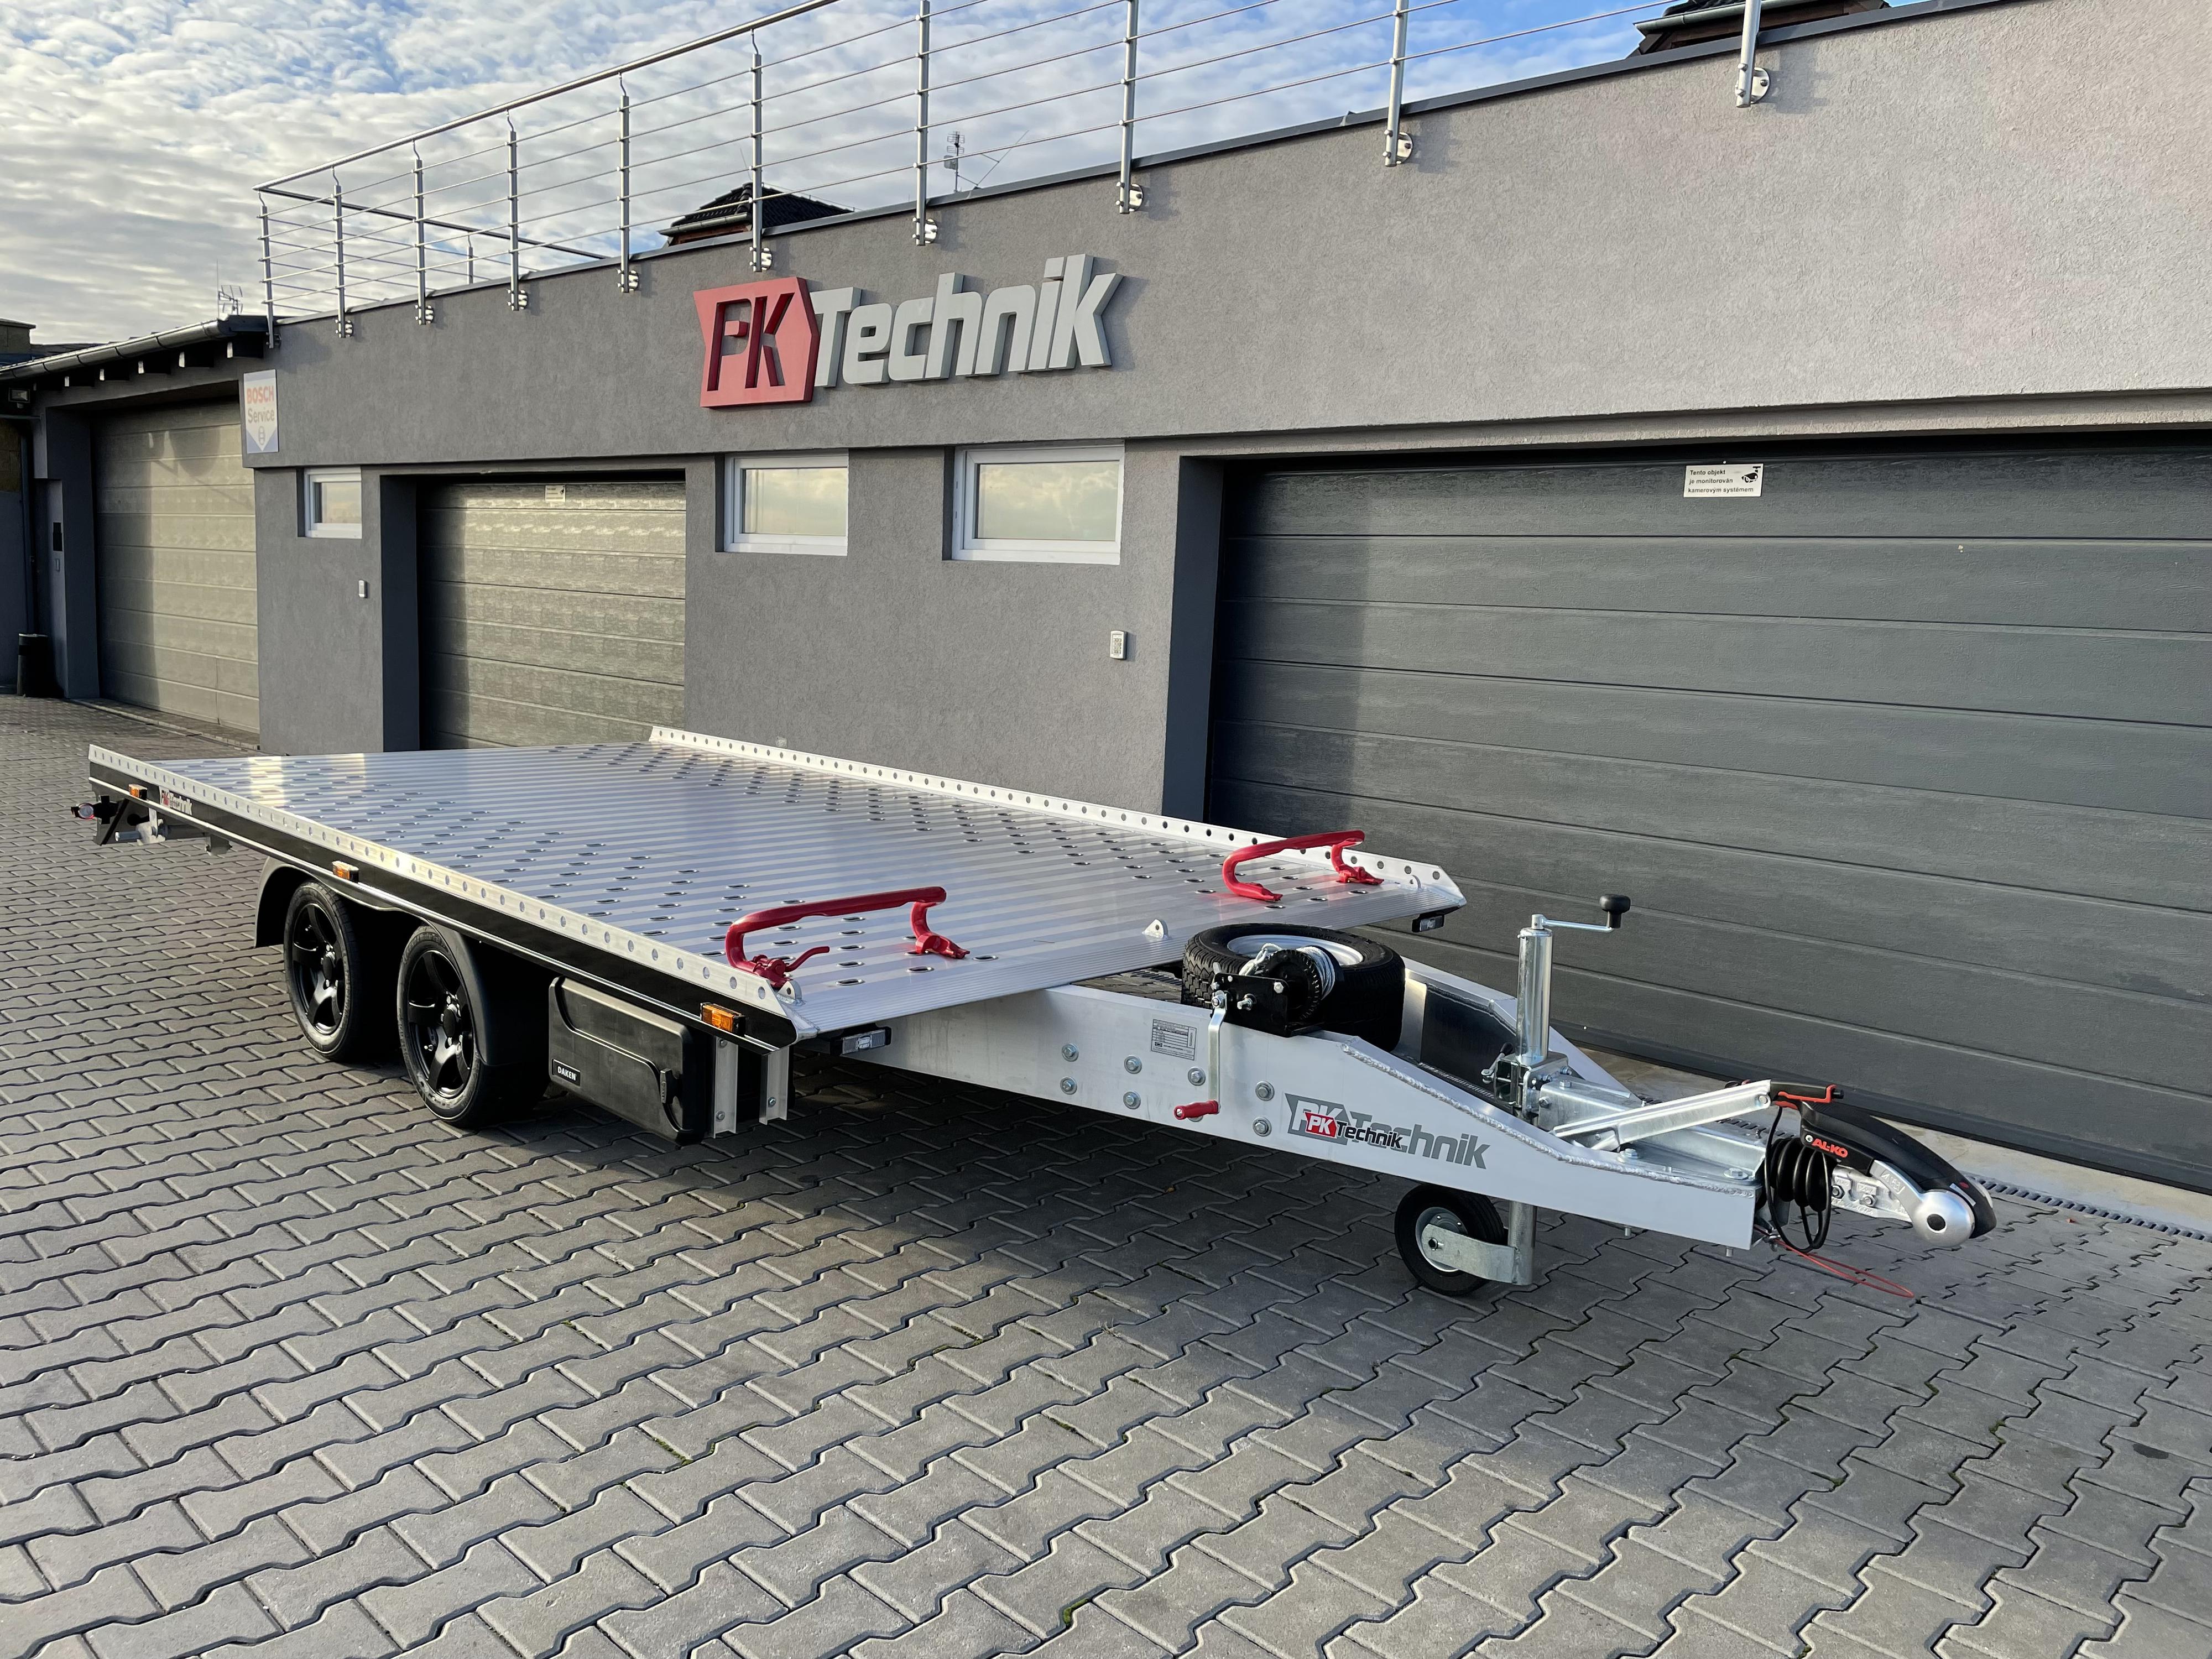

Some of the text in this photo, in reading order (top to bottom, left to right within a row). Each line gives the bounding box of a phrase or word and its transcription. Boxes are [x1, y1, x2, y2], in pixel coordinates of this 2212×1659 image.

[707, 254, 1123, 391] PK Technik
[247, 385, 274, 404] BOSCH
[248, 408, 275, 423] Service
[557, 1066, 576, 1081] DAKEN
[1308, 1115, 1403, 1149] PK Technik
[1812, 1138, 1848, 1158] AL-KO
